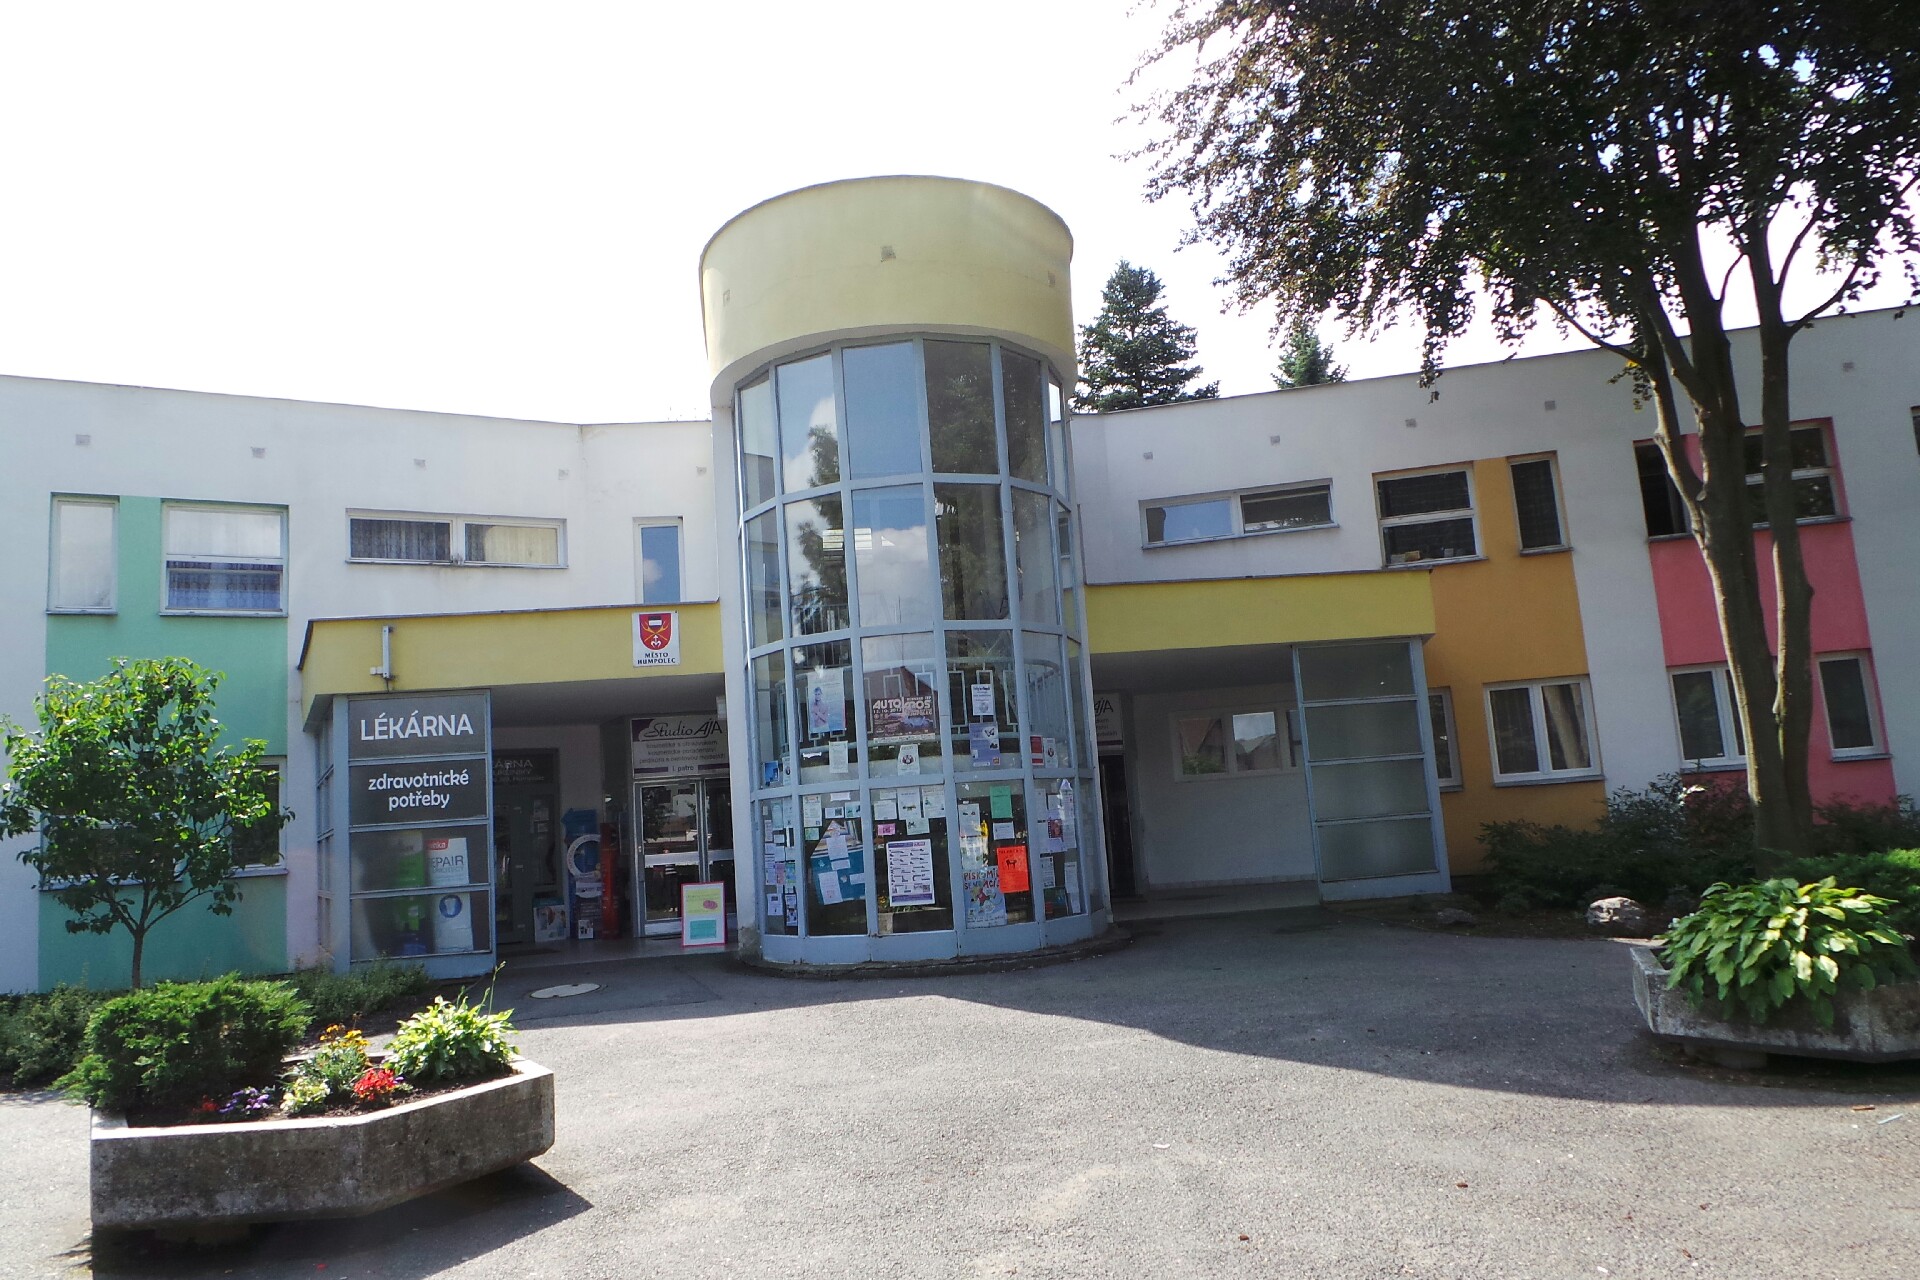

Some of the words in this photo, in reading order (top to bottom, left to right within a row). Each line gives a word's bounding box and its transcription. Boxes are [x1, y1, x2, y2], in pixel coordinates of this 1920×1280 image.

[637, 657, 676, 665] HUMPOLEC
[873, 699, 901, 710] AUTO
[361, 710, 474, 741] LÉKÁRNA
[643, 720, 693, 738] Studio
[678, 764, 694, 772] patro
[368, 768, 469, 790] zdravotnické
[388, 790, 450, 811] potřeby
